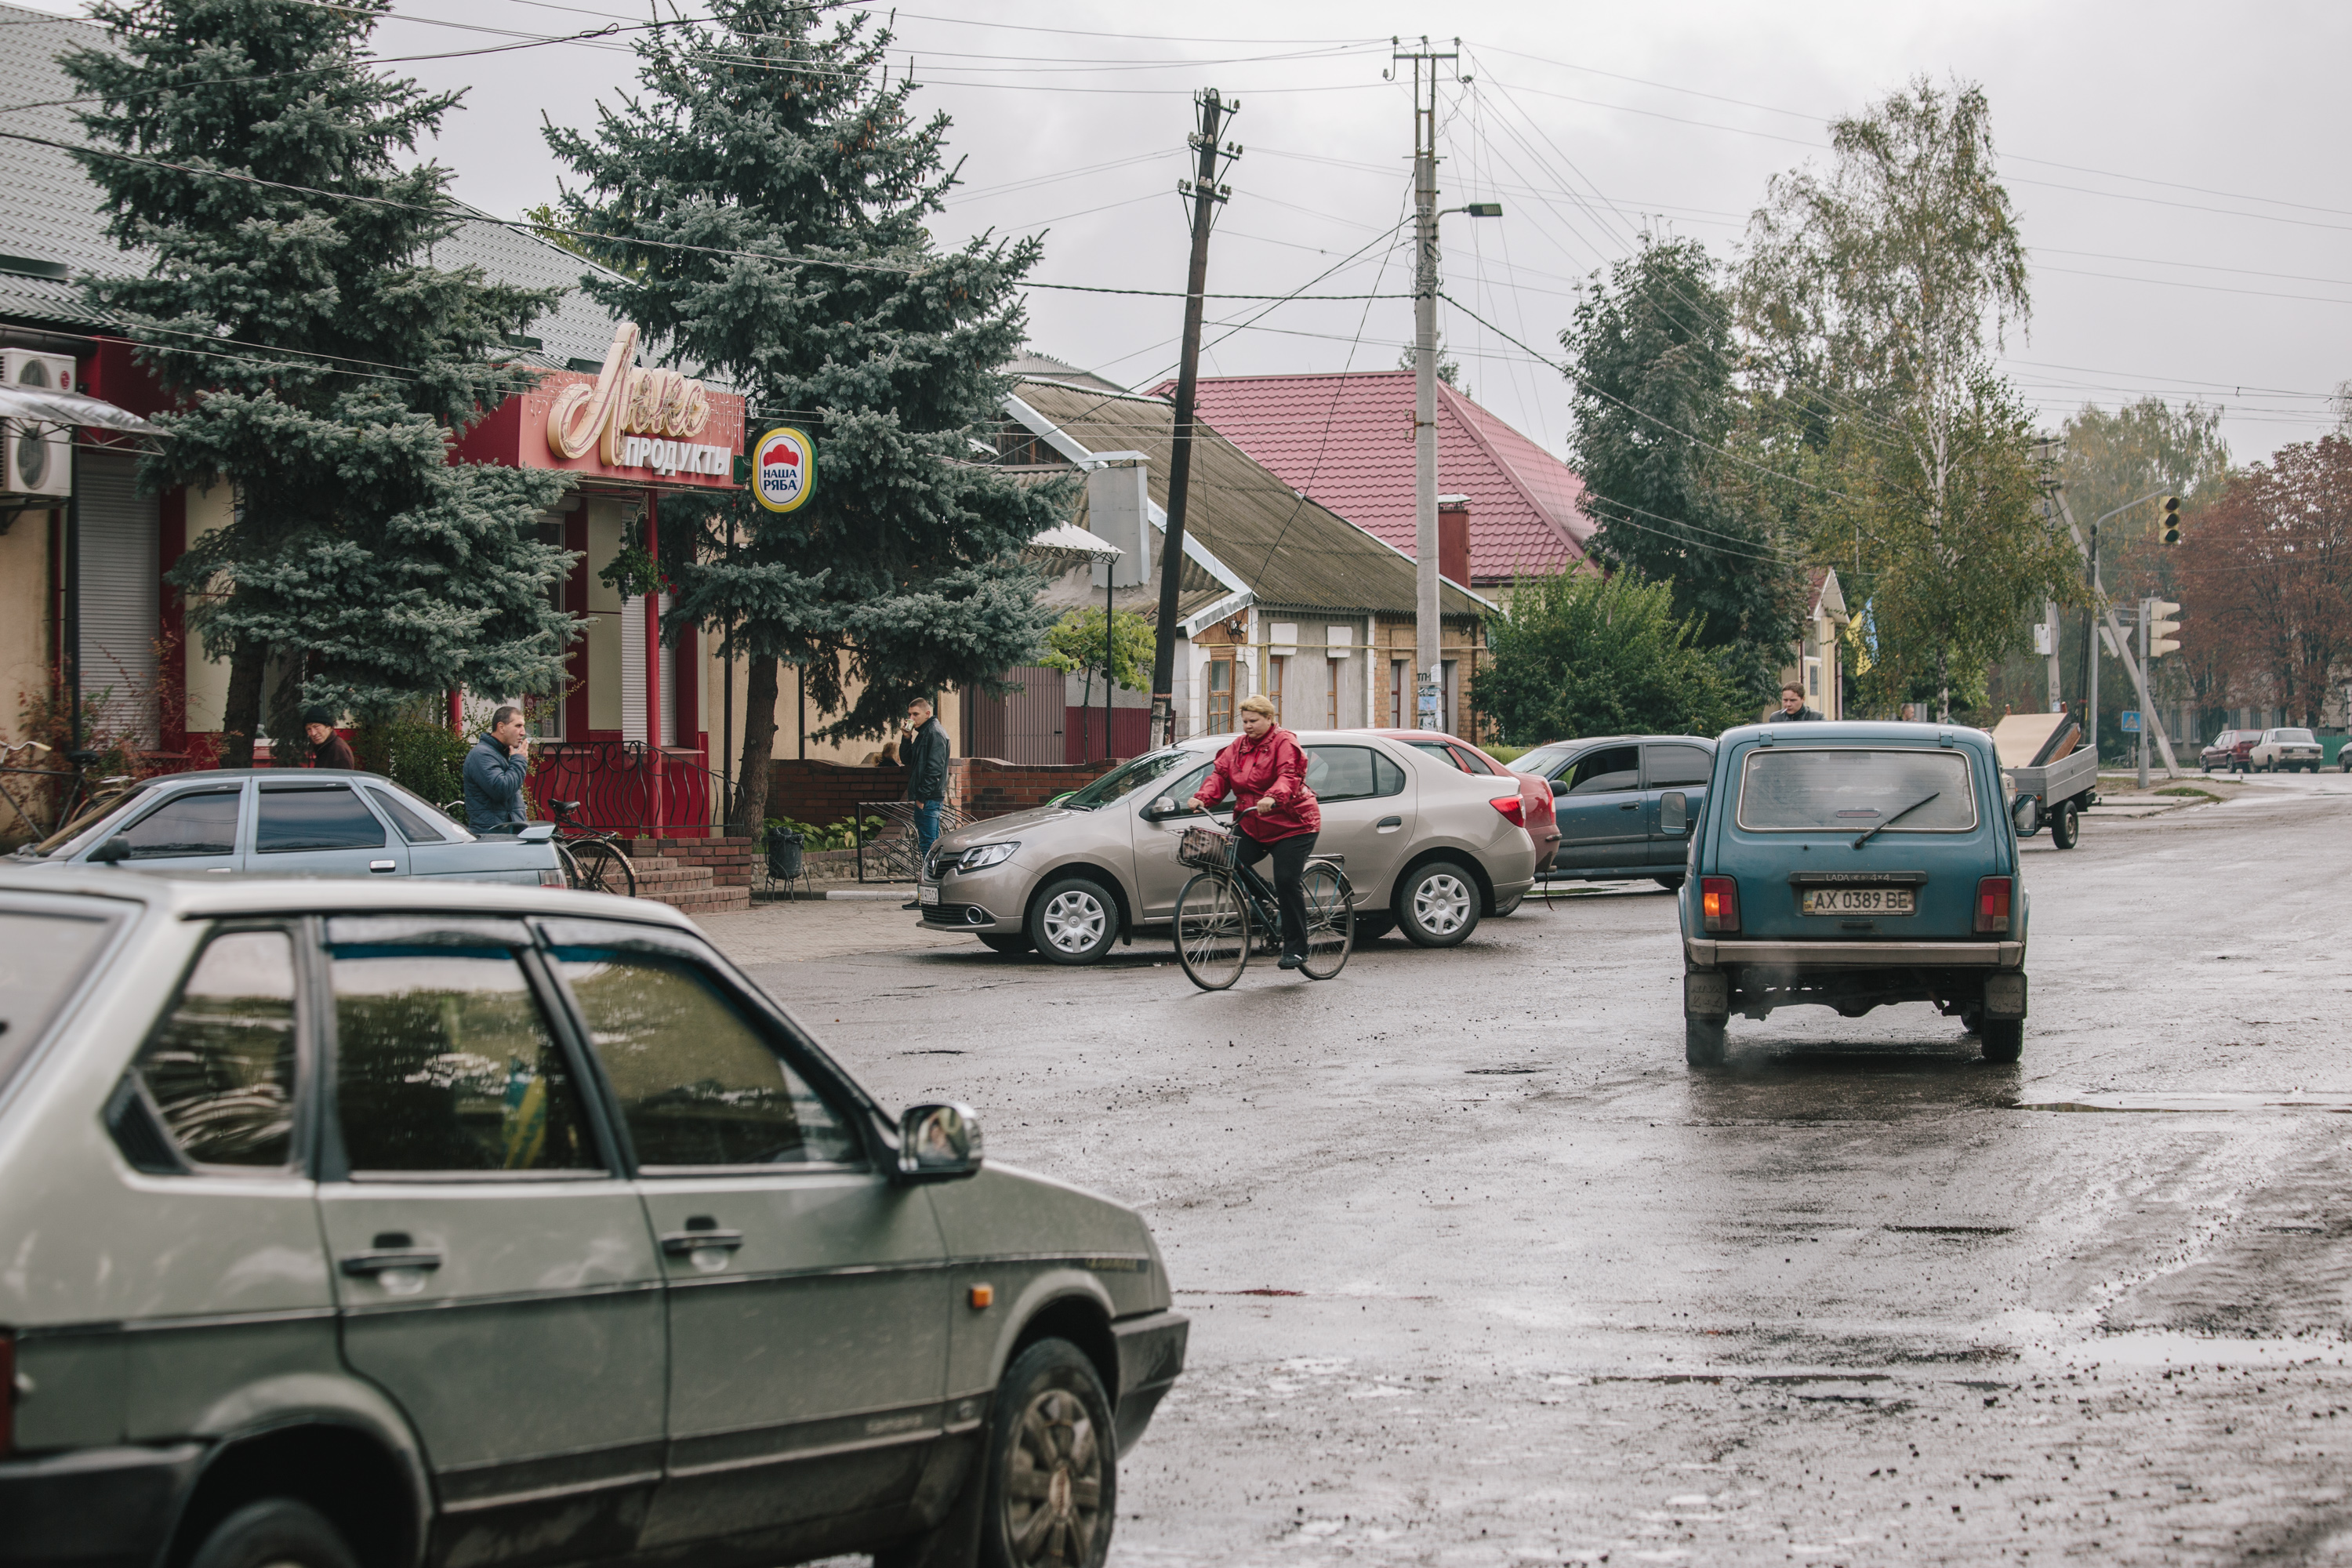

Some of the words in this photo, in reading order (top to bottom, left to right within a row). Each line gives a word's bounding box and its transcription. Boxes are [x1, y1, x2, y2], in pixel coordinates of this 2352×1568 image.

[623, 436, 731, 477] ПРОДУКТЫ
[764, 469, 797, 478] НАША
[764, 479, 798, 491] РЯБА
[1814, 892, 1837, 909] AX
[1843, 892, 1881, 909] 0389
[1886, 892, 1908, 909] BE
